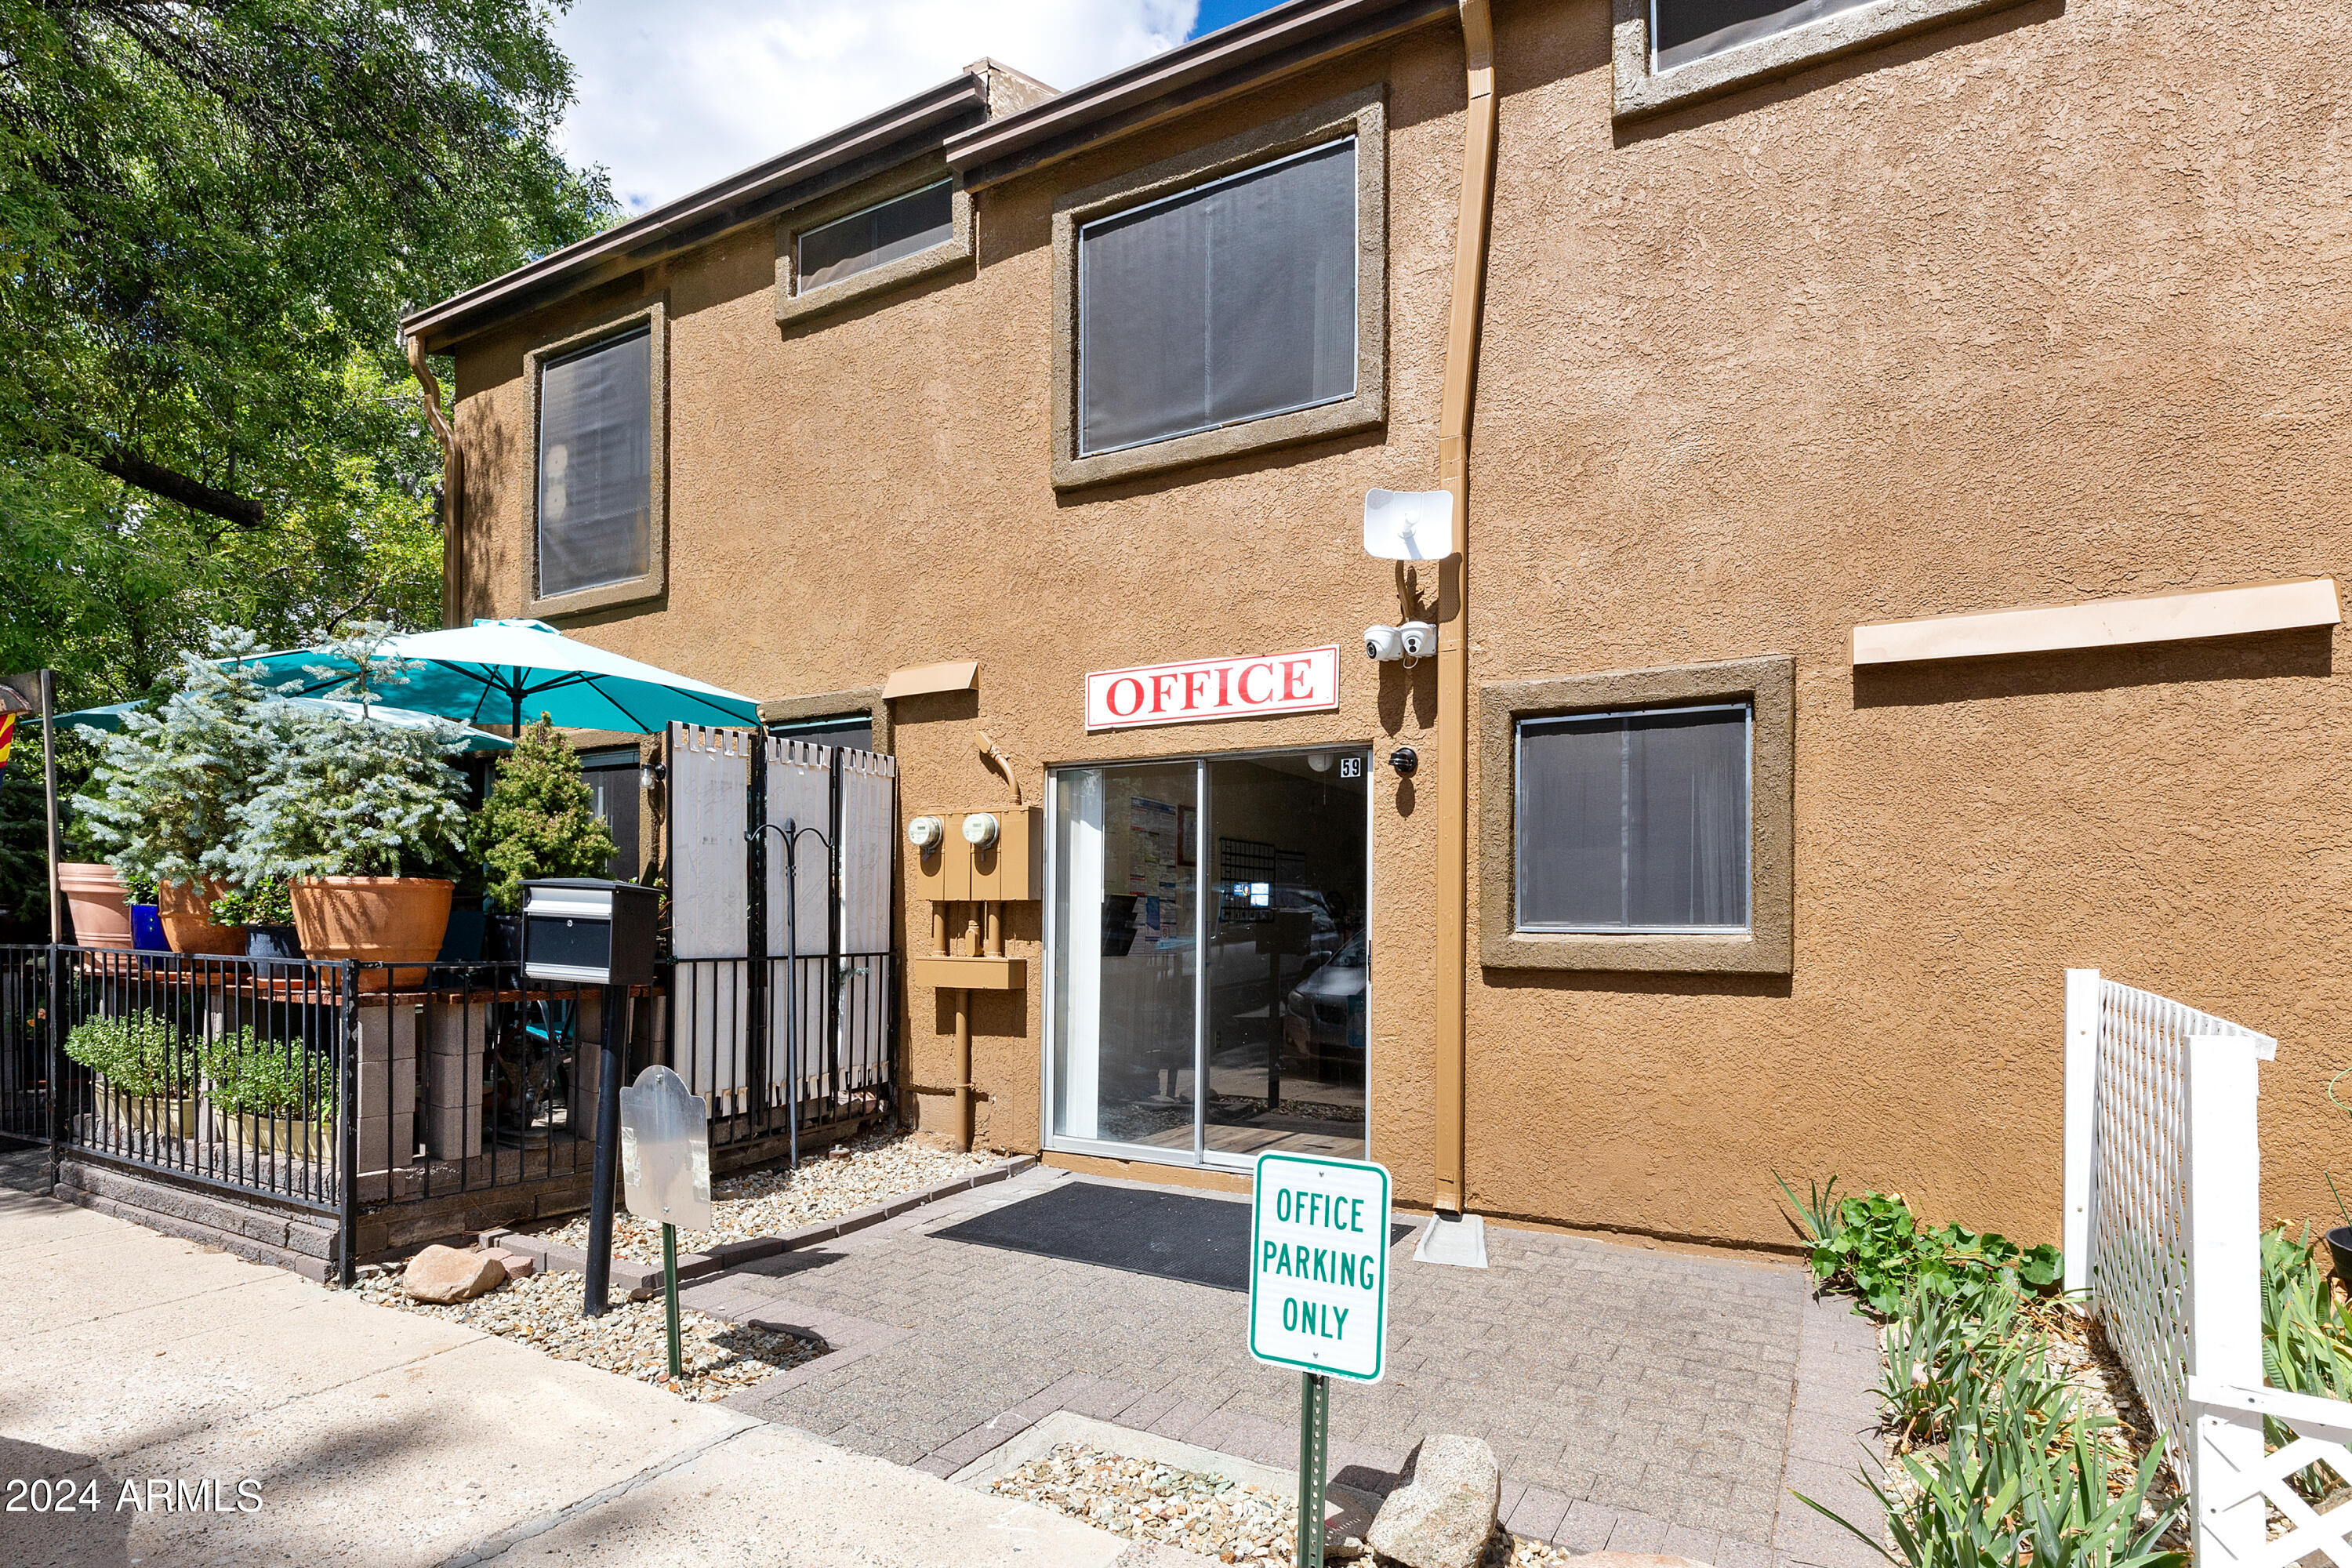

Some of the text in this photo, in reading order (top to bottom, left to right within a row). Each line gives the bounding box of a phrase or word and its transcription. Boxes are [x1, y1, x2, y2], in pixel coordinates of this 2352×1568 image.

[1106, 659, 1313, 717] OFFICE
[1343, 759, 1359, 776] 59
[1276, 1188, 1364, 1233] OFFICE
[1262, 1240, 1374, 1290] PARKING
[1283, 1297, 1349, 1341] ONLY
